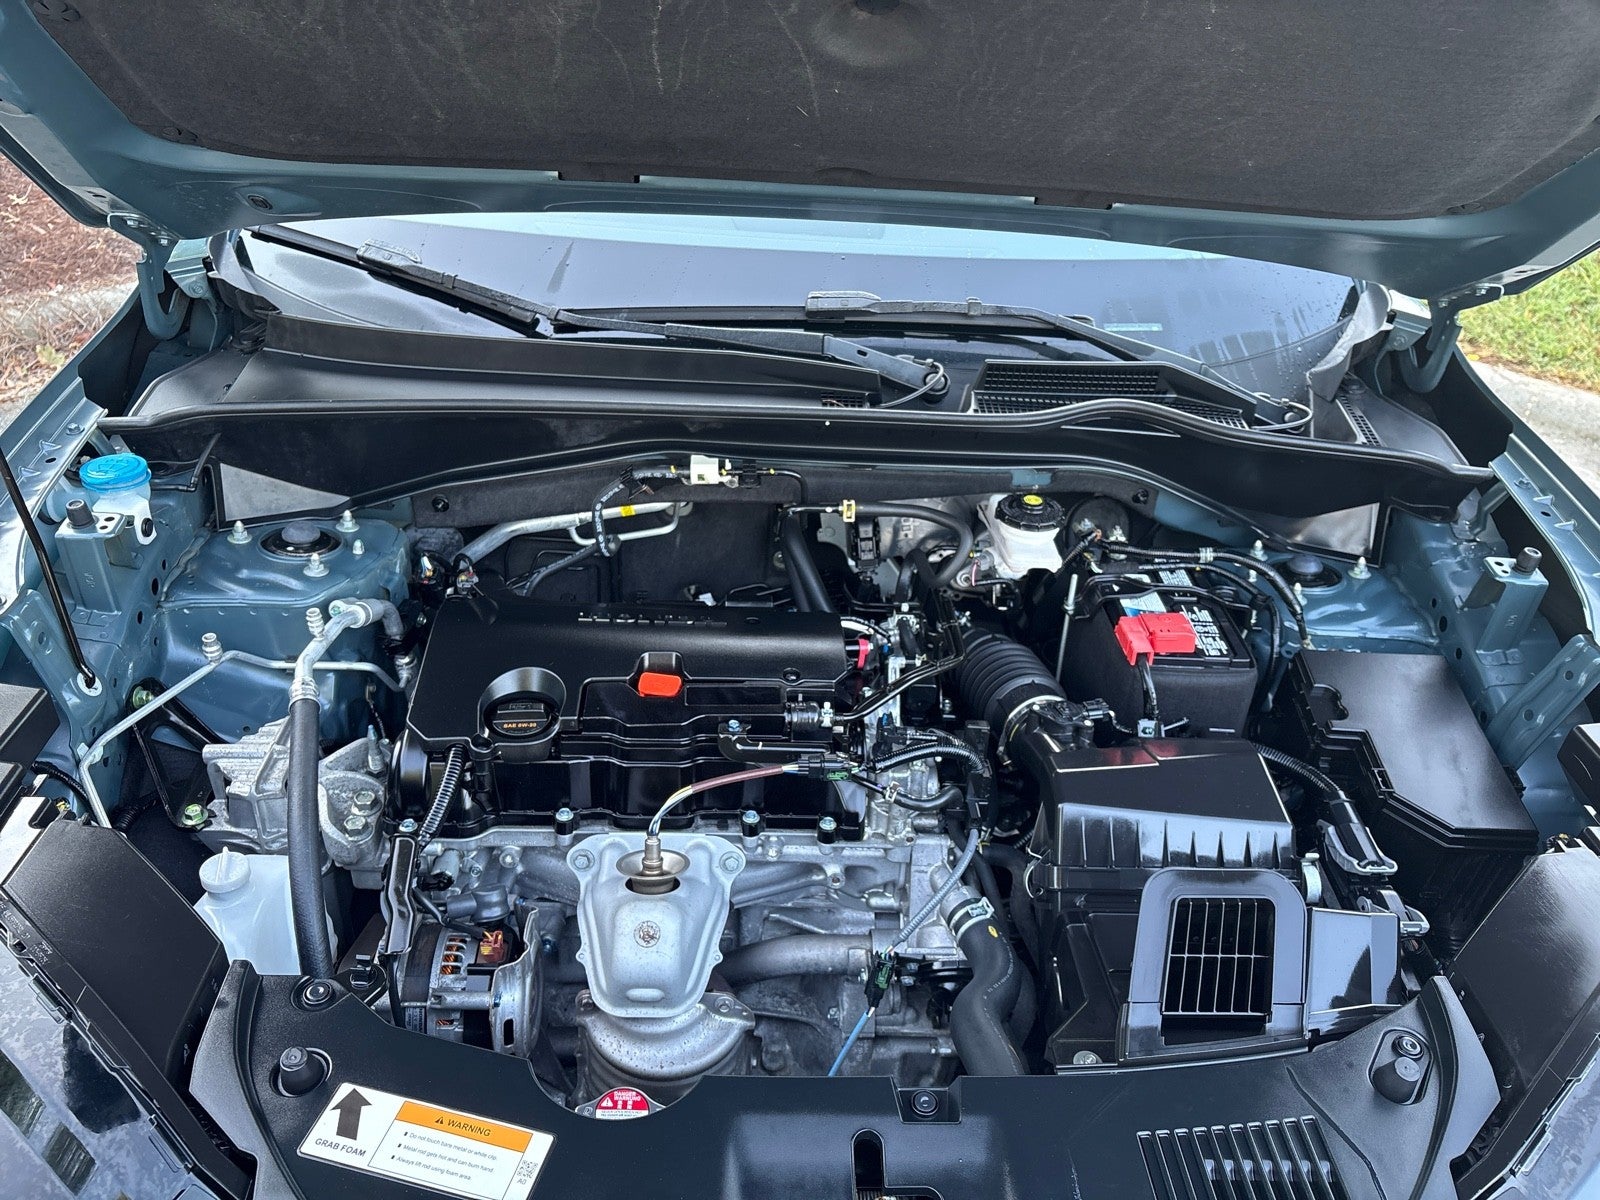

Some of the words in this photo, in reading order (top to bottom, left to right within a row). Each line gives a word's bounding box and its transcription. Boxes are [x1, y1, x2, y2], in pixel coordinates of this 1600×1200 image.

[447, 1118, 492, 1137] WARNING
[315, 1138, 340, 1150] GRAB
[340, 1144, 367, 1157] FOAM
[403, 1144, 418, 1152] Metal
[426, 1137, 441, 1145] touch
[440, 1140, 453, 1148] bare
[452, 1144, 468, 1152] metal
[396, 1156, 414, 1165] Always
[430, 1166, 445, 1175] using
